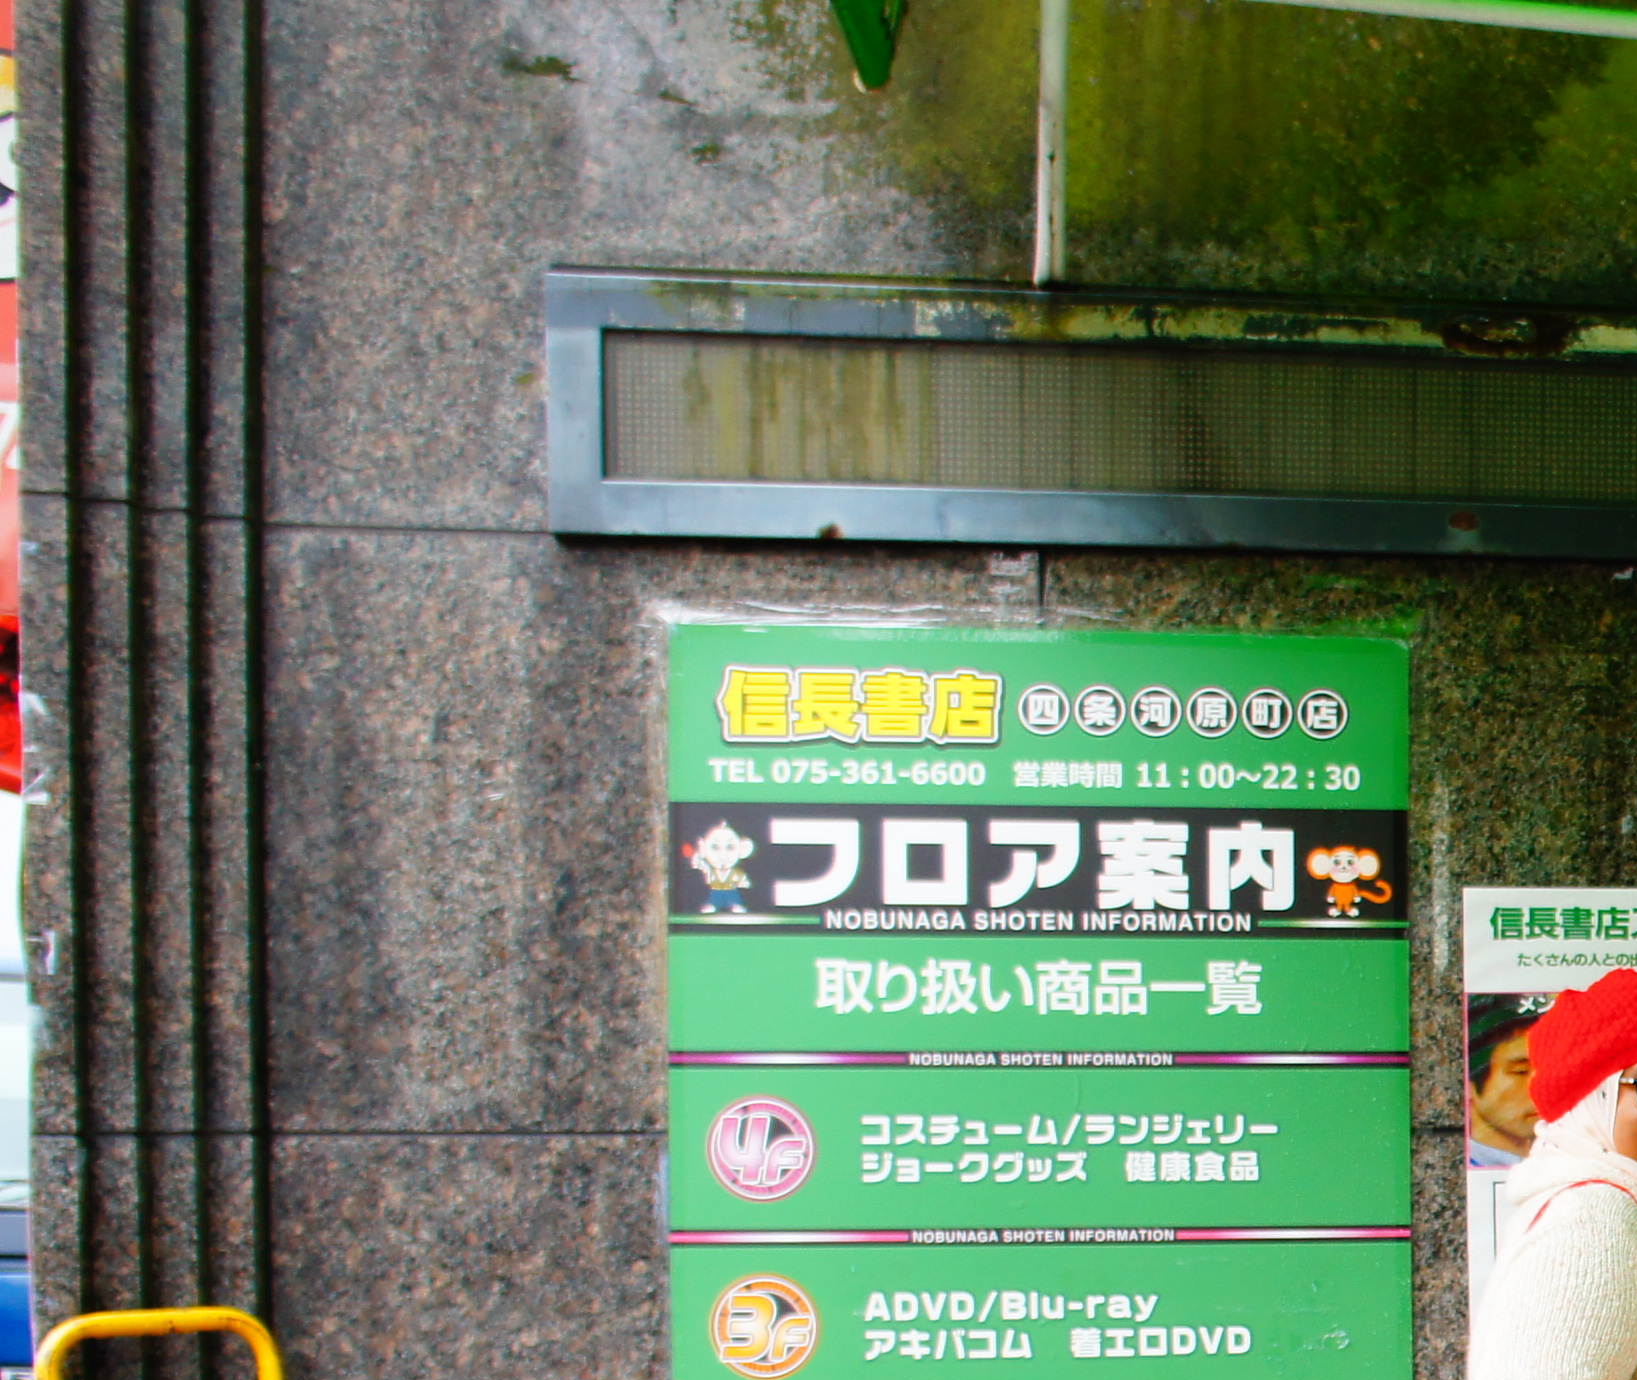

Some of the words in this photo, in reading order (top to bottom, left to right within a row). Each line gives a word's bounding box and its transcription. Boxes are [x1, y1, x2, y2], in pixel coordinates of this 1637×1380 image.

[722, 667, 1000, 741] 信長書店
[1018, 685, 1348, 739] 四条河原町店
[709, 760, 764, 784] TEL
[771, 760, 986, 788] 075-361-6600
[1013, 762, 1124, 790] 営業時間
[770, 818, 1296, 911] フロア案内
[825, 909, 967, 933] NOBUNAGA
[974, 910, 1074, 932] SHOTEN
[1082, 911, 1253, 934] INFORMATION
[815, 958, 1264, 1017] 取り扱い商品一覧
[910, 1053, 994, 1067] NOBUNAGA
[1000, 1053, 1062, 1066] SHOTEN
[1067, 1052, 1173, 1067] INFORMATION
[860, 1114, 1279, 1149] コスチューム/ランジェリー
[720, 1114, 812, 1187] 4F
[860, 1150, 1088, 1185] ジョークグッズ
[1125, 1151, 1261, 1183] 健康食品
[912, 1229, 998, 1244] NOBUNAGA
[1002, 1229, 1066, 1243] SHOTEN
[1069, 1228, 1175, 1243] INFORMATION
[864, 1291, 1160, 1324] ADVD/Blu-ray
[720, 1291, 816, 1364] 3F
[864, 1327, 1035, 1361] アキバコム
[1070, 1325, 1252, 1360] 着エロDVD
